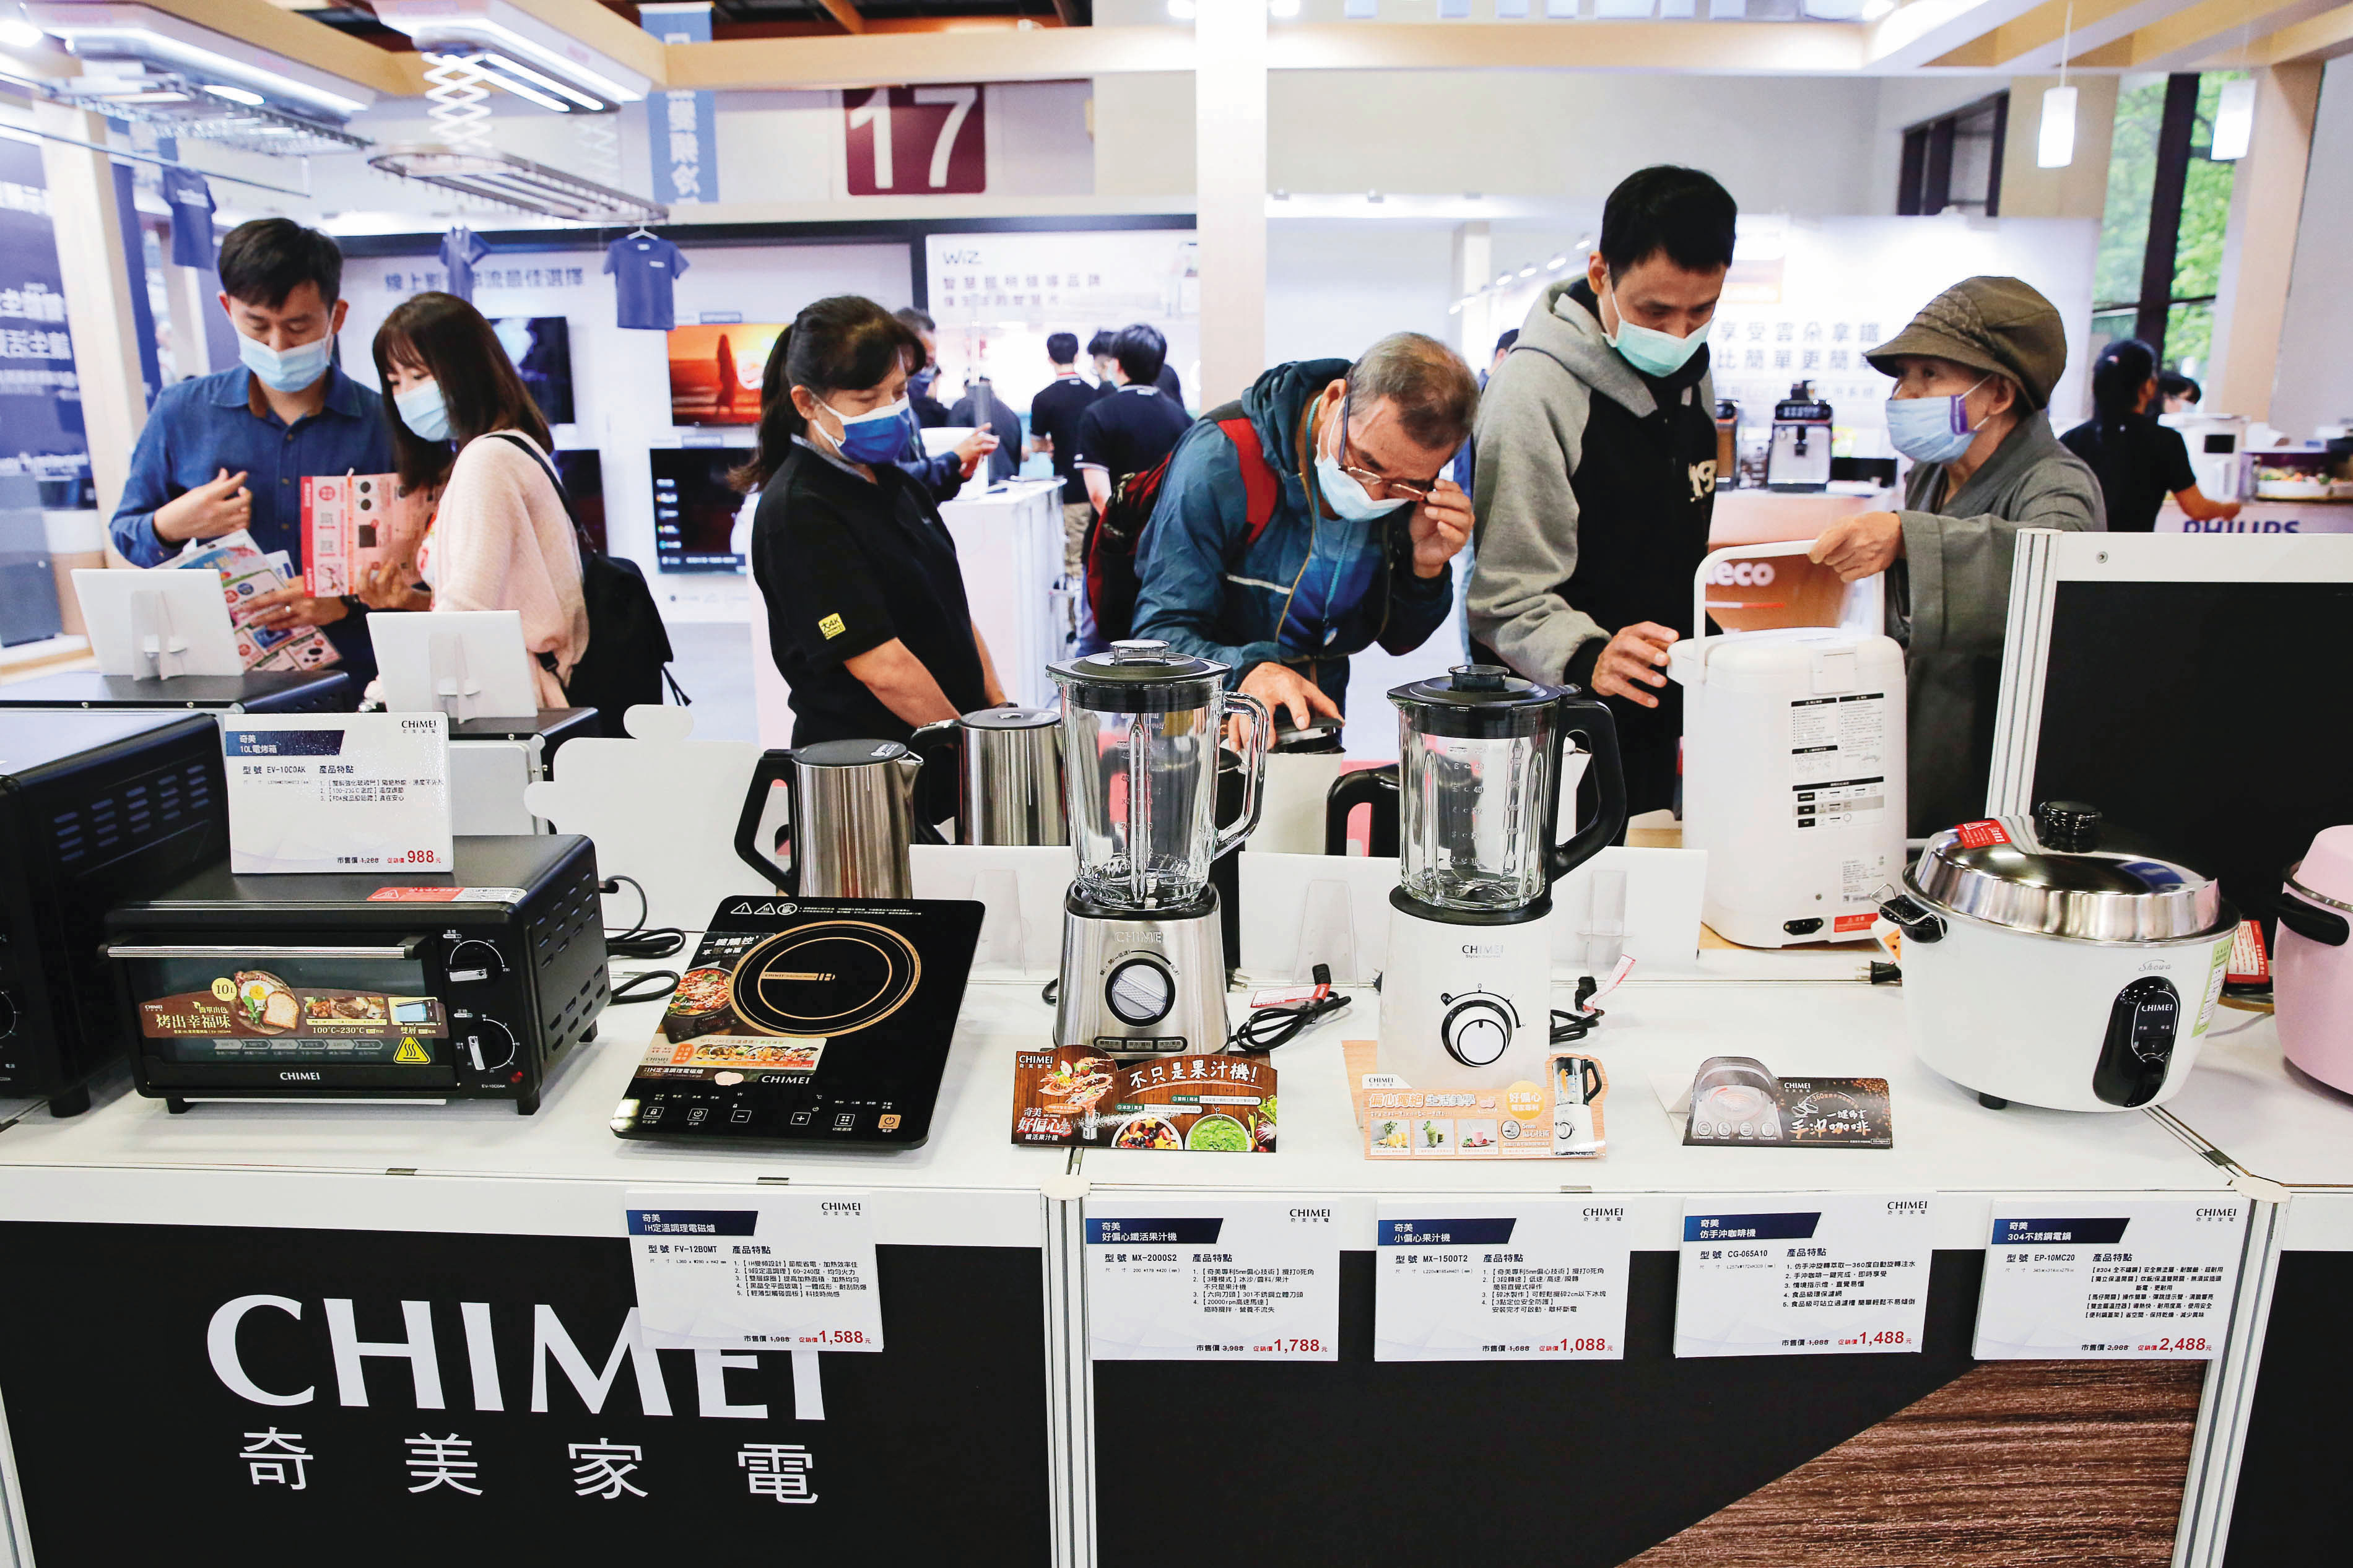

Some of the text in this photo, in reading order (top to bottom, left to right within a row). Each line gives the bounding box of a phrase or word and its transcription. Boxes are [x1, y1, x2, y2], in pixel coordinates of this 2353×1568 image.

[848, 87, 978, 189] 17
[401, 720, 437, 729] CHIMEI
[239, 734, 256, 743] 奇美
[319, 765, 354, 774] 產品特點
[407, 850, 435, 864] 988
[1462, 945, 1504, 954] CHIMEI
[2141, 1003, 2173, 1012] CHIMEI
[156, 1014, 232, 1029] 烤出幸福味
[1019, 1055, 1053, 1064] CHIMEI
[279, 1071, 321, 1081] CHIMEI
[1129, 1059, 1258, 1089] 不只是果汁機!
[761, 1075, 811, 1085] CHIMEI
[1024, 1107, 1043, 1118] 奇美
[821, 1202, 861, 1211] CHIMEI
[1887, 1201, 1928, 1210] CHIMEI
[1290, 1208, 1331, 1218] CHIMEI
[1583, 1208, 1624, 1216] CHIMEI
[2196, 1208, 2237, 1217] CHIMEI
[642, 1213, 661, 1223] 奇美
[1700, 1218, 1720, 1228] 奇美
[1102, 1221, 1121, 1231] 奇美
[1394, 1223, 1413, 1232] 奇美
[2009, 1221, 2029, 1231] 奇美
[1102, 1232, 1178, 1242] 好偏心纖活果汁機
[1394, 1233, 1451, 1242] 小偏心果汁機
[1699, 1229, 1757, 1239] 仿手沖咖啡機
[648, 1244, 669, 1254] 型號
[733, 1245, 771, 1255] 產品特點
[1786, 1247, 1827, 1257] 產品特點
[1105, 1254, 1177, 1262] 型號 MX-2000S2
[1192, 1254, 1233, 1263] 產品特點
[1395, 1255, 1418, 1264] 型號
[1483, 1254, 1524, 1263] 產品特點
[1700, 1249, 1768, 1260] 型號 CG-065A10
[2006, 1254, 2075, 1263] 型號 EP-10MC20
[2092, 1253, 2133, 1262] 產品特點
[744, 1335, 767, 1343] 市售價
[819, 1330, 864, 1346] 1,588
[1781, 1338, 1805, 1347] 市售價
[1838, 1338, 1858, 1346] 促銷價
[1858, 1330, 1905, 1347] 1,488
[1274, 1338, 1320, 1354] 1,788
[1482, 1345, 1505, 1353] 市售價
[1559, 1338, 1606, 1354] 1,088
[2081, 1343, 2105, 1351] 市售價
[2159, 1337, 2206, 1353] 2,488
[207, 1294, 825, 1420] CHIMEI
[238, 1426, 819, 1504] 奇美家電
